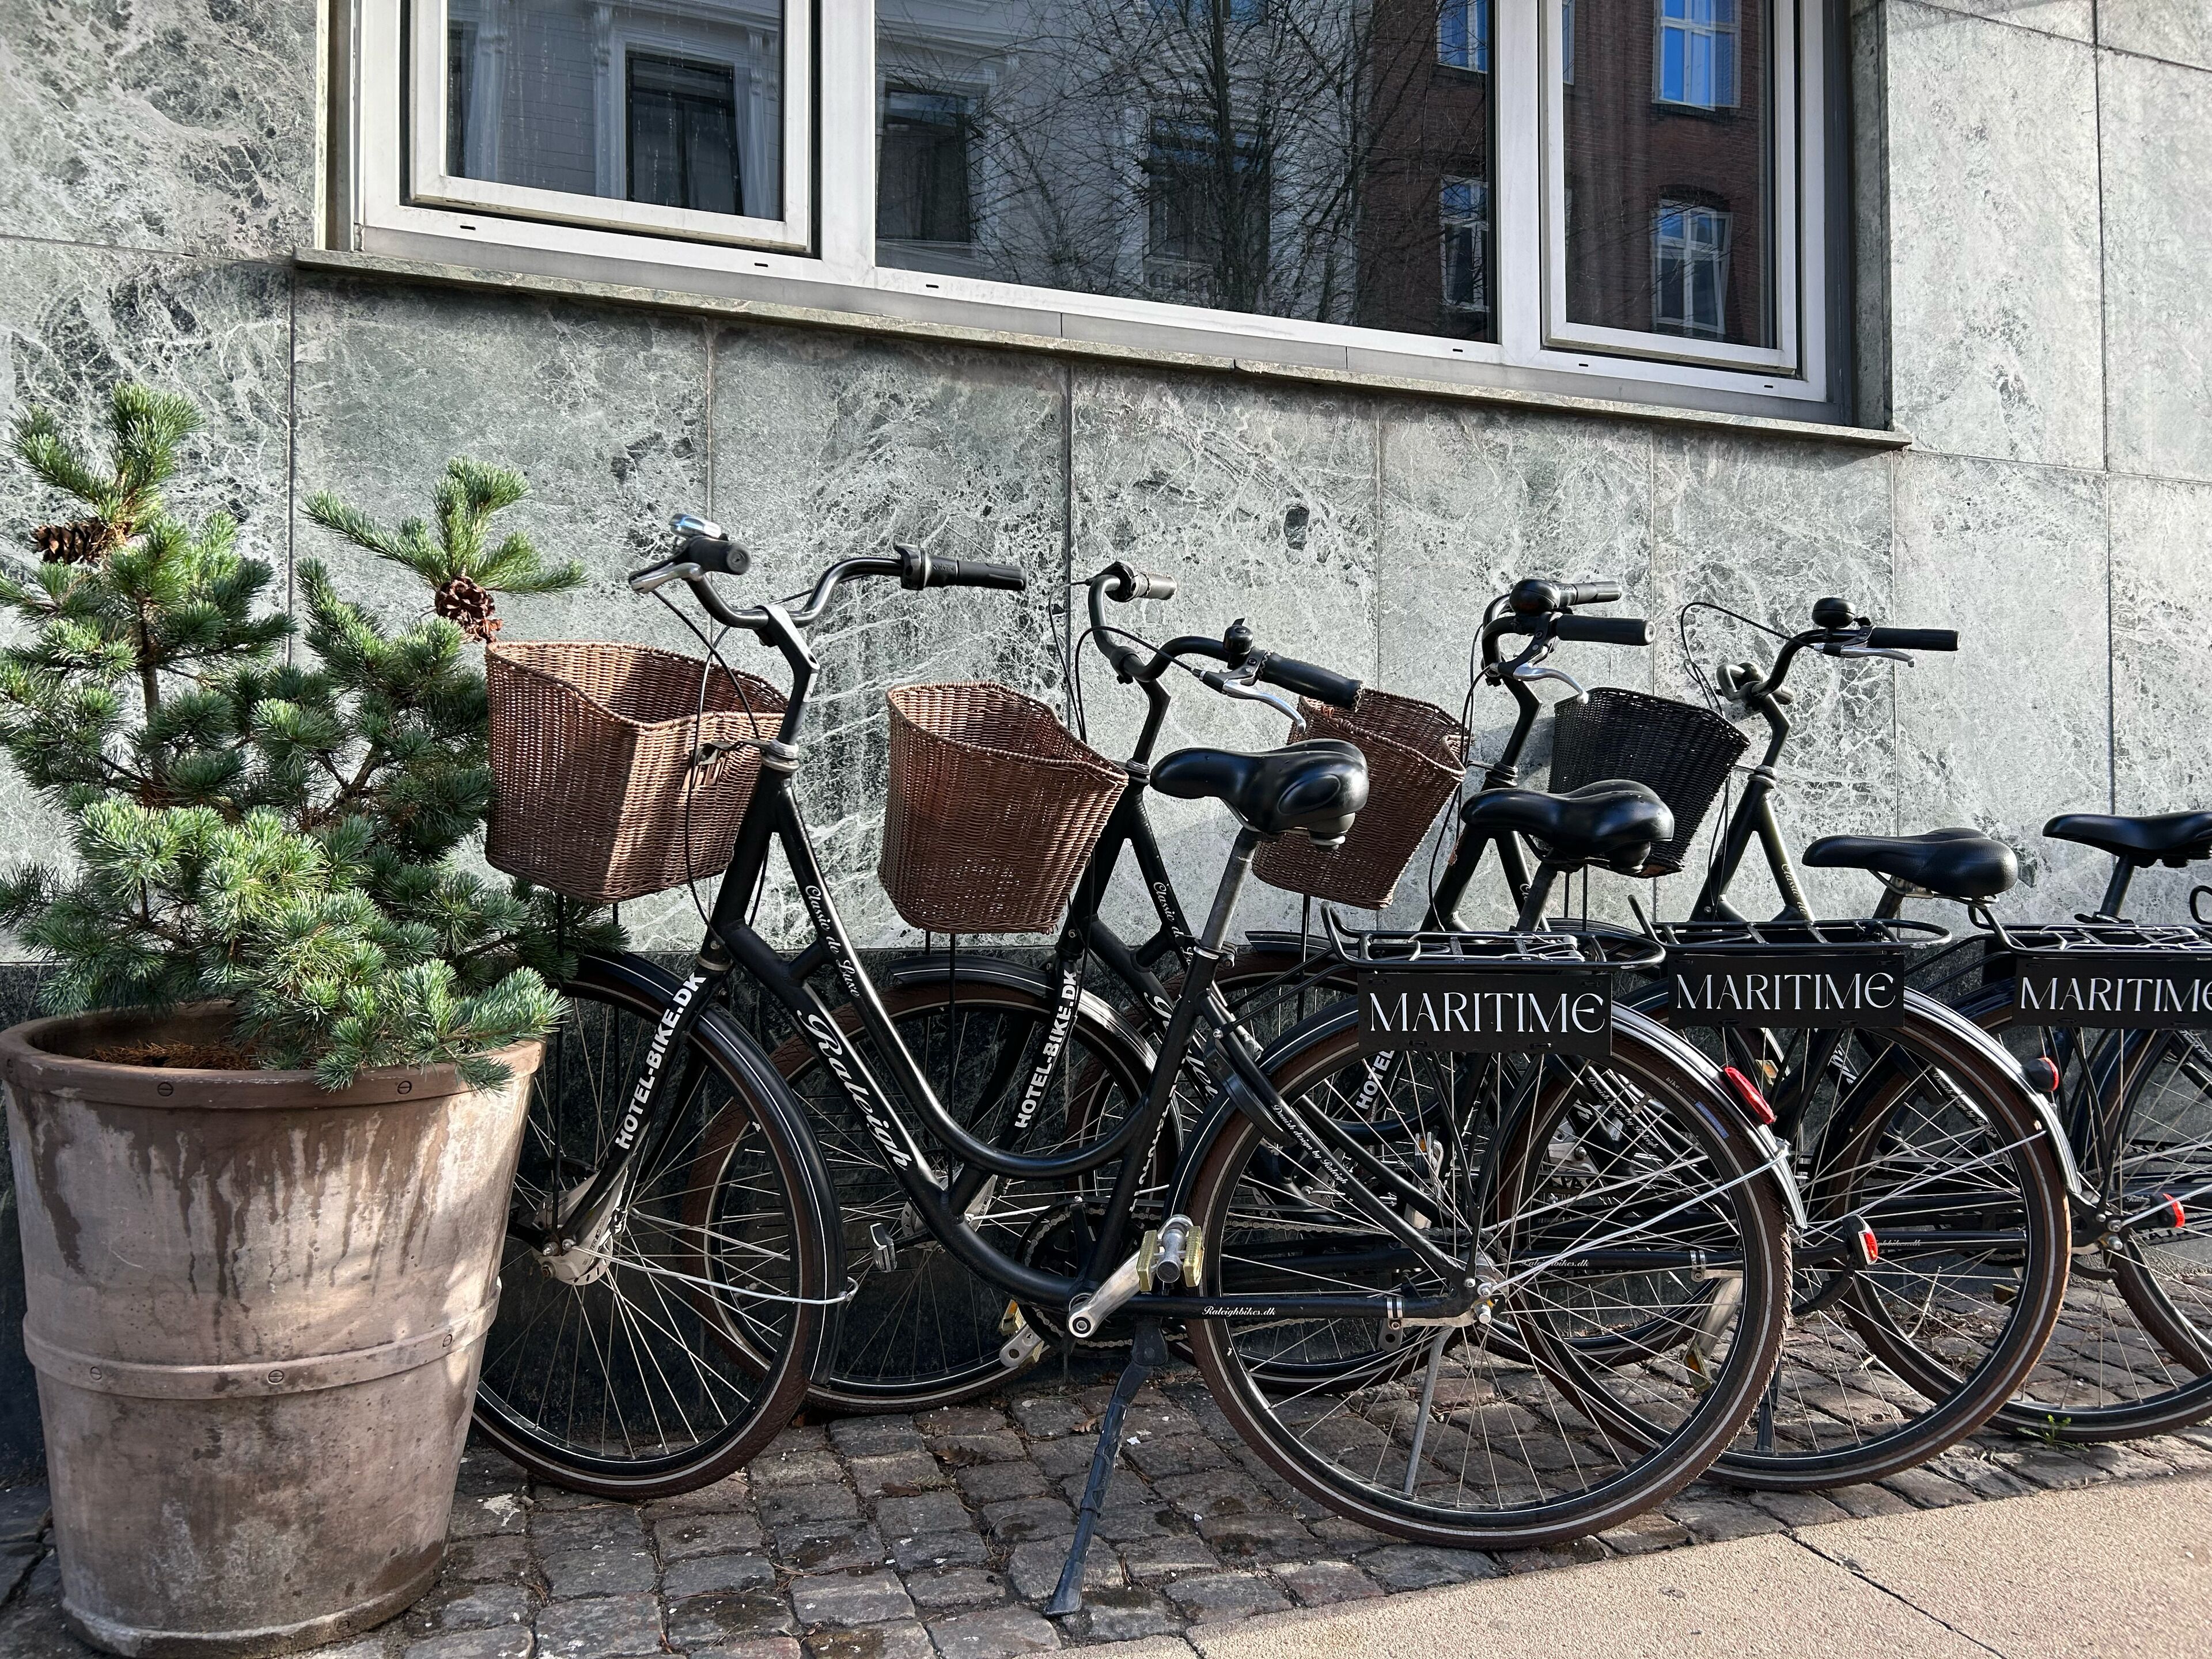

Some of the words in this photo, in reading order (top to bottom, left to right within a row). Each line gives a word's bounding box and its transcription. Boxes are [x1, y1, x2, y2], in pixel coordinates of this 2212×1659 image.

[1153, 881, 1175, 922] Classic
[805, 885, 831, 932] Classic
[826, 935, 841, 955] de
[835, 959, 861, 998] Luxe
[1369, 992, 1605, 1033] MARITIME
[1676, 972, 1896, 1010] MARITIME
[615, 972, 707, 1150] HOTEL-BIKE.DK
[1014, 969, 1078, 1128] HOTEL-BIKE.DK
[796, 1009, 912, 1170] Raleigh
[1586, 1077, 1610, 1103] Danish
[1624, 1118, 1634, 1126] by
[1932, 1073, 1953, 1094] Danish
[1950, 1094, 1968, 1111] dsign
[1271, 1104, 1296, 1130] Danish
[1293, 1130, 1313, 1151] design
[1312, 1150, 1322, 1159] by
[1320, 1159, 1349, 1184] Raleigh
[1202, 1305, 1277, 1317] Raleighbikes.dk
